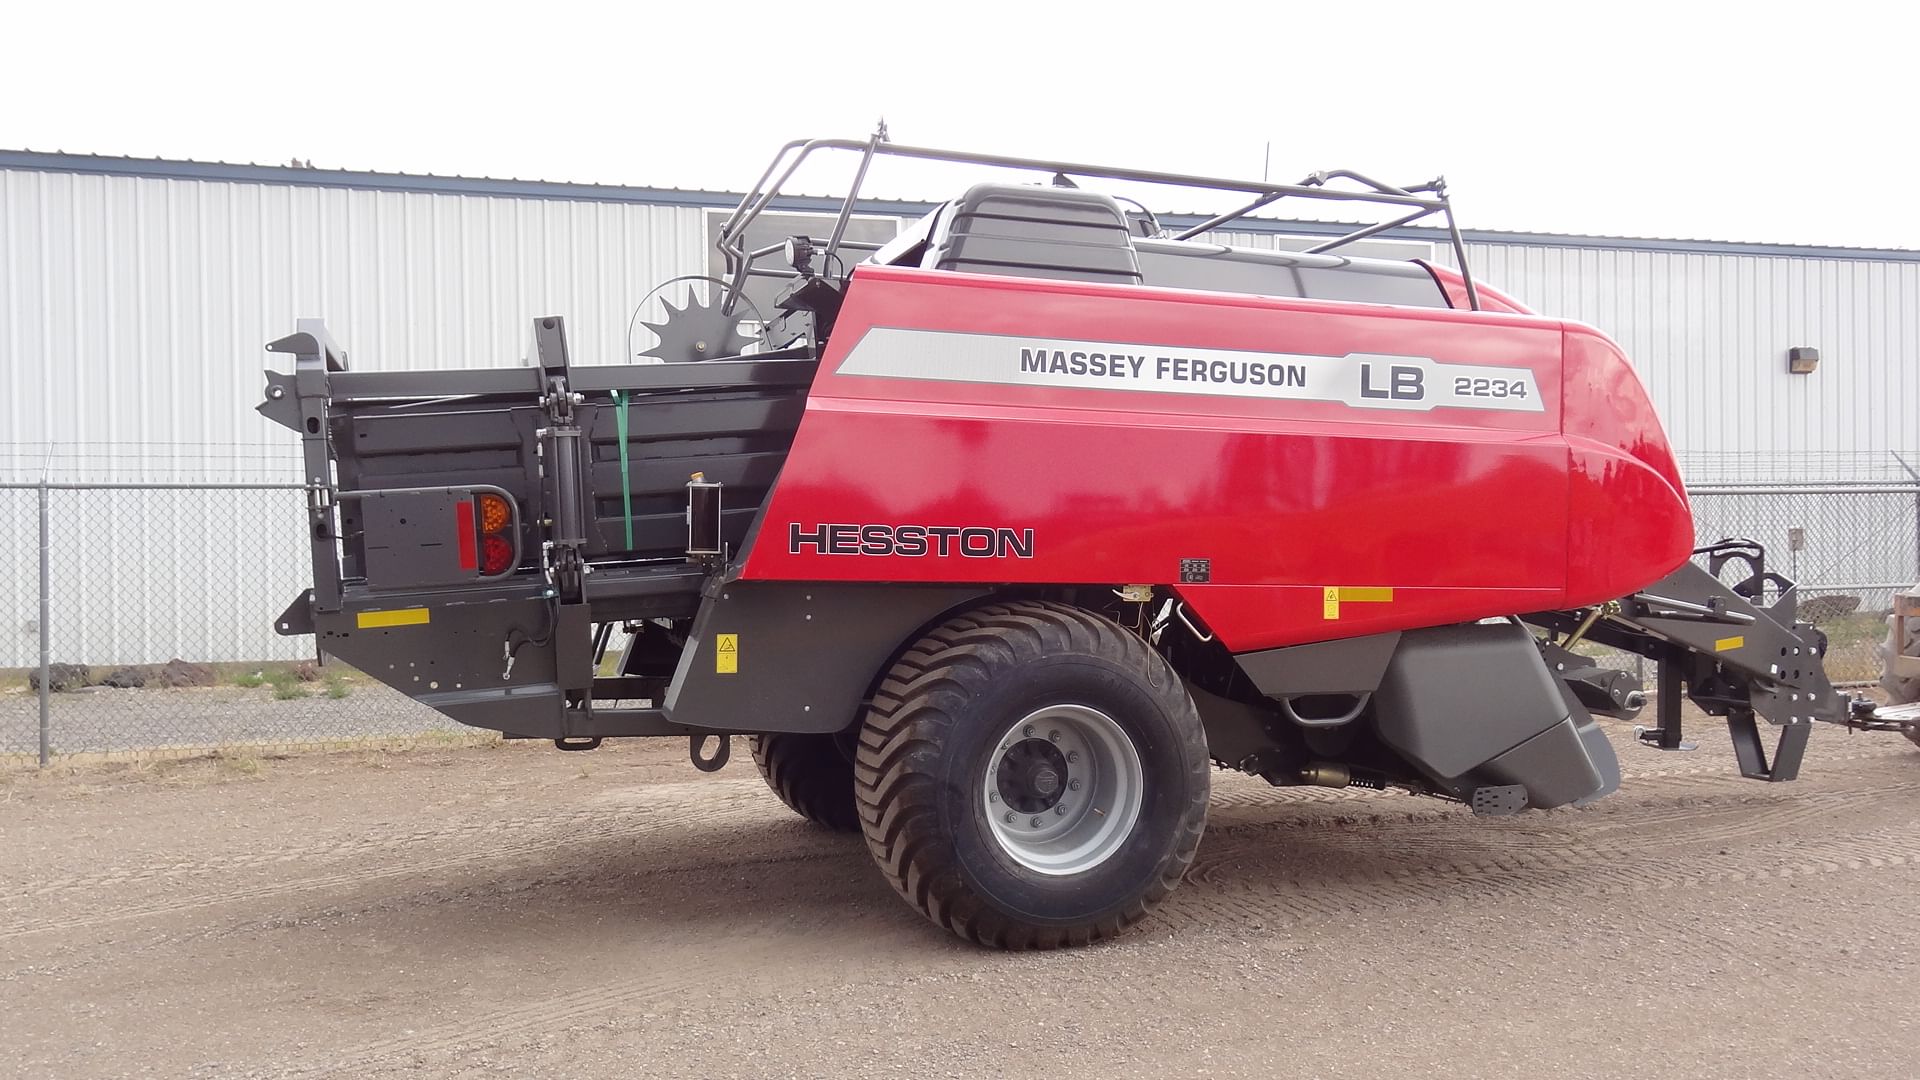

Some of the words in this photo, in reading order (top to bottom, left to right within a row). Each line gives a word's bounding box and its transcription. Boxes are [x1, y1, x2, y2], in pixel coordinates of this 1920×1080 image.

[1020, 348, 1145, 378] MASSEY
[1156, 357, 1306, 387] FERGUSON
[1360, 363, 1425, 401] LB
[1454, 377, 1527, 399] 2234
[789, 522, 1034, 558] HESSTON
